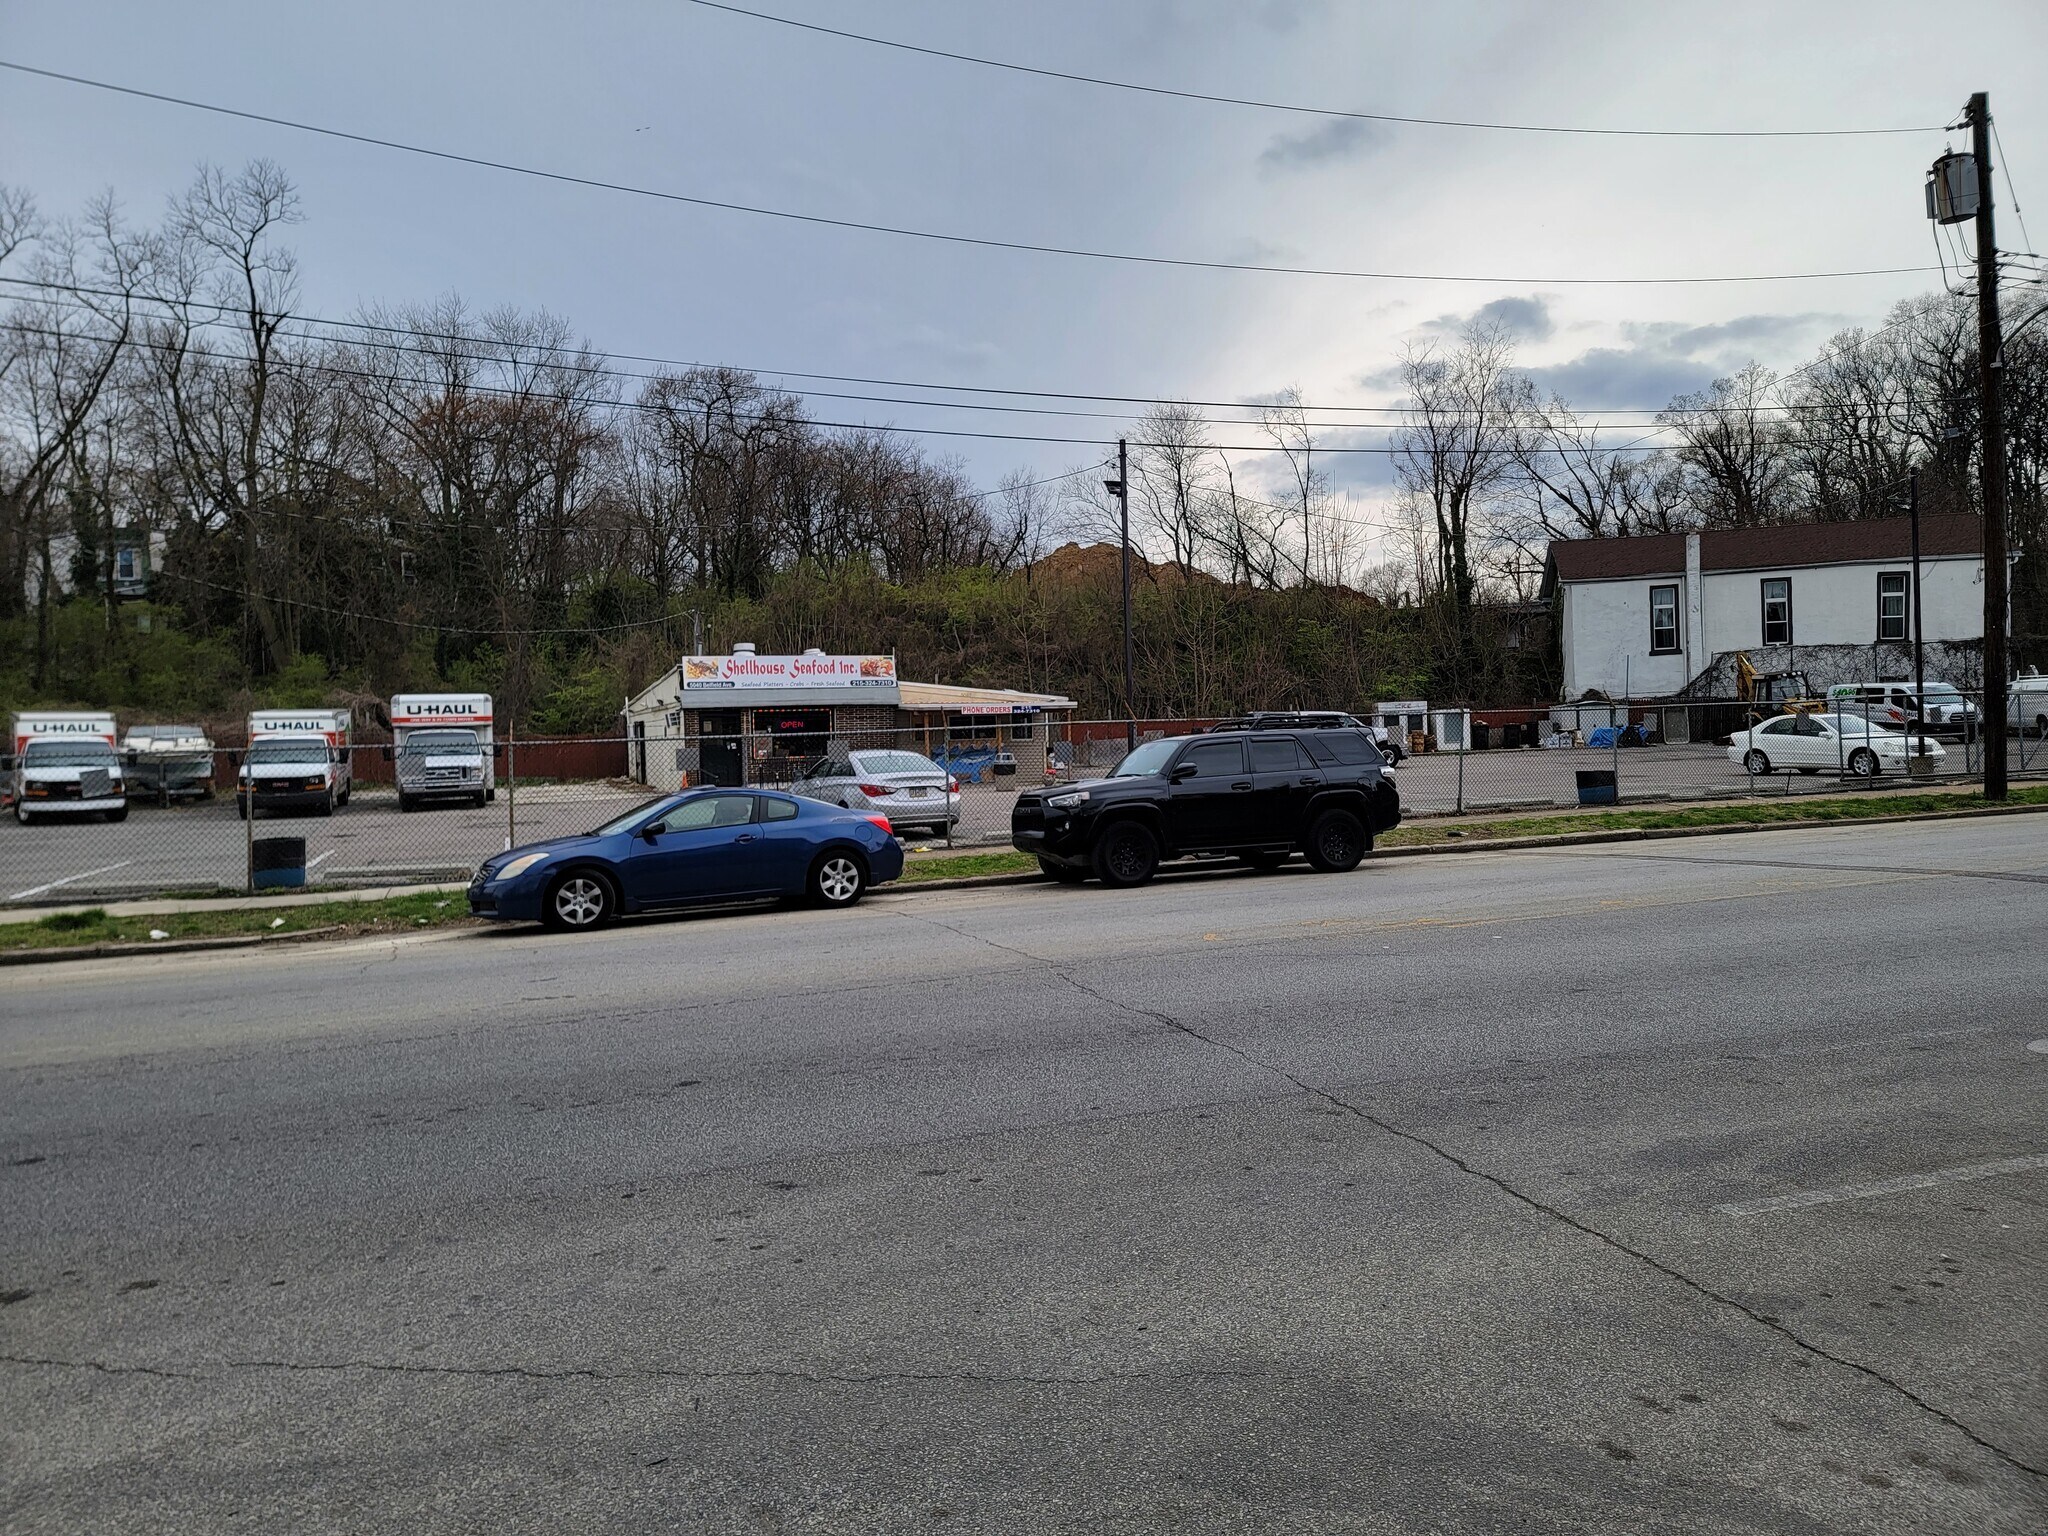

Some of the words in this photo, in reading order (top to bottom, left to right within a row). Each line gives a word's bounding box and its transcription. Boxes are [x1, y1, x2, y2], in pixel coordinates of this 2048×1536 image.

[722, 659, 785, 679] Shellhouse
[789, 659, 835, 679] Seafood
[839, 660, 858, 674] Inc.
[406, 705, 478, 715] U-HAUL
[33, 724, 102, 733] U-HAUL
[264, 722, 325, 731] U-HAUL
[781, 721, 804, 729] OPEN
